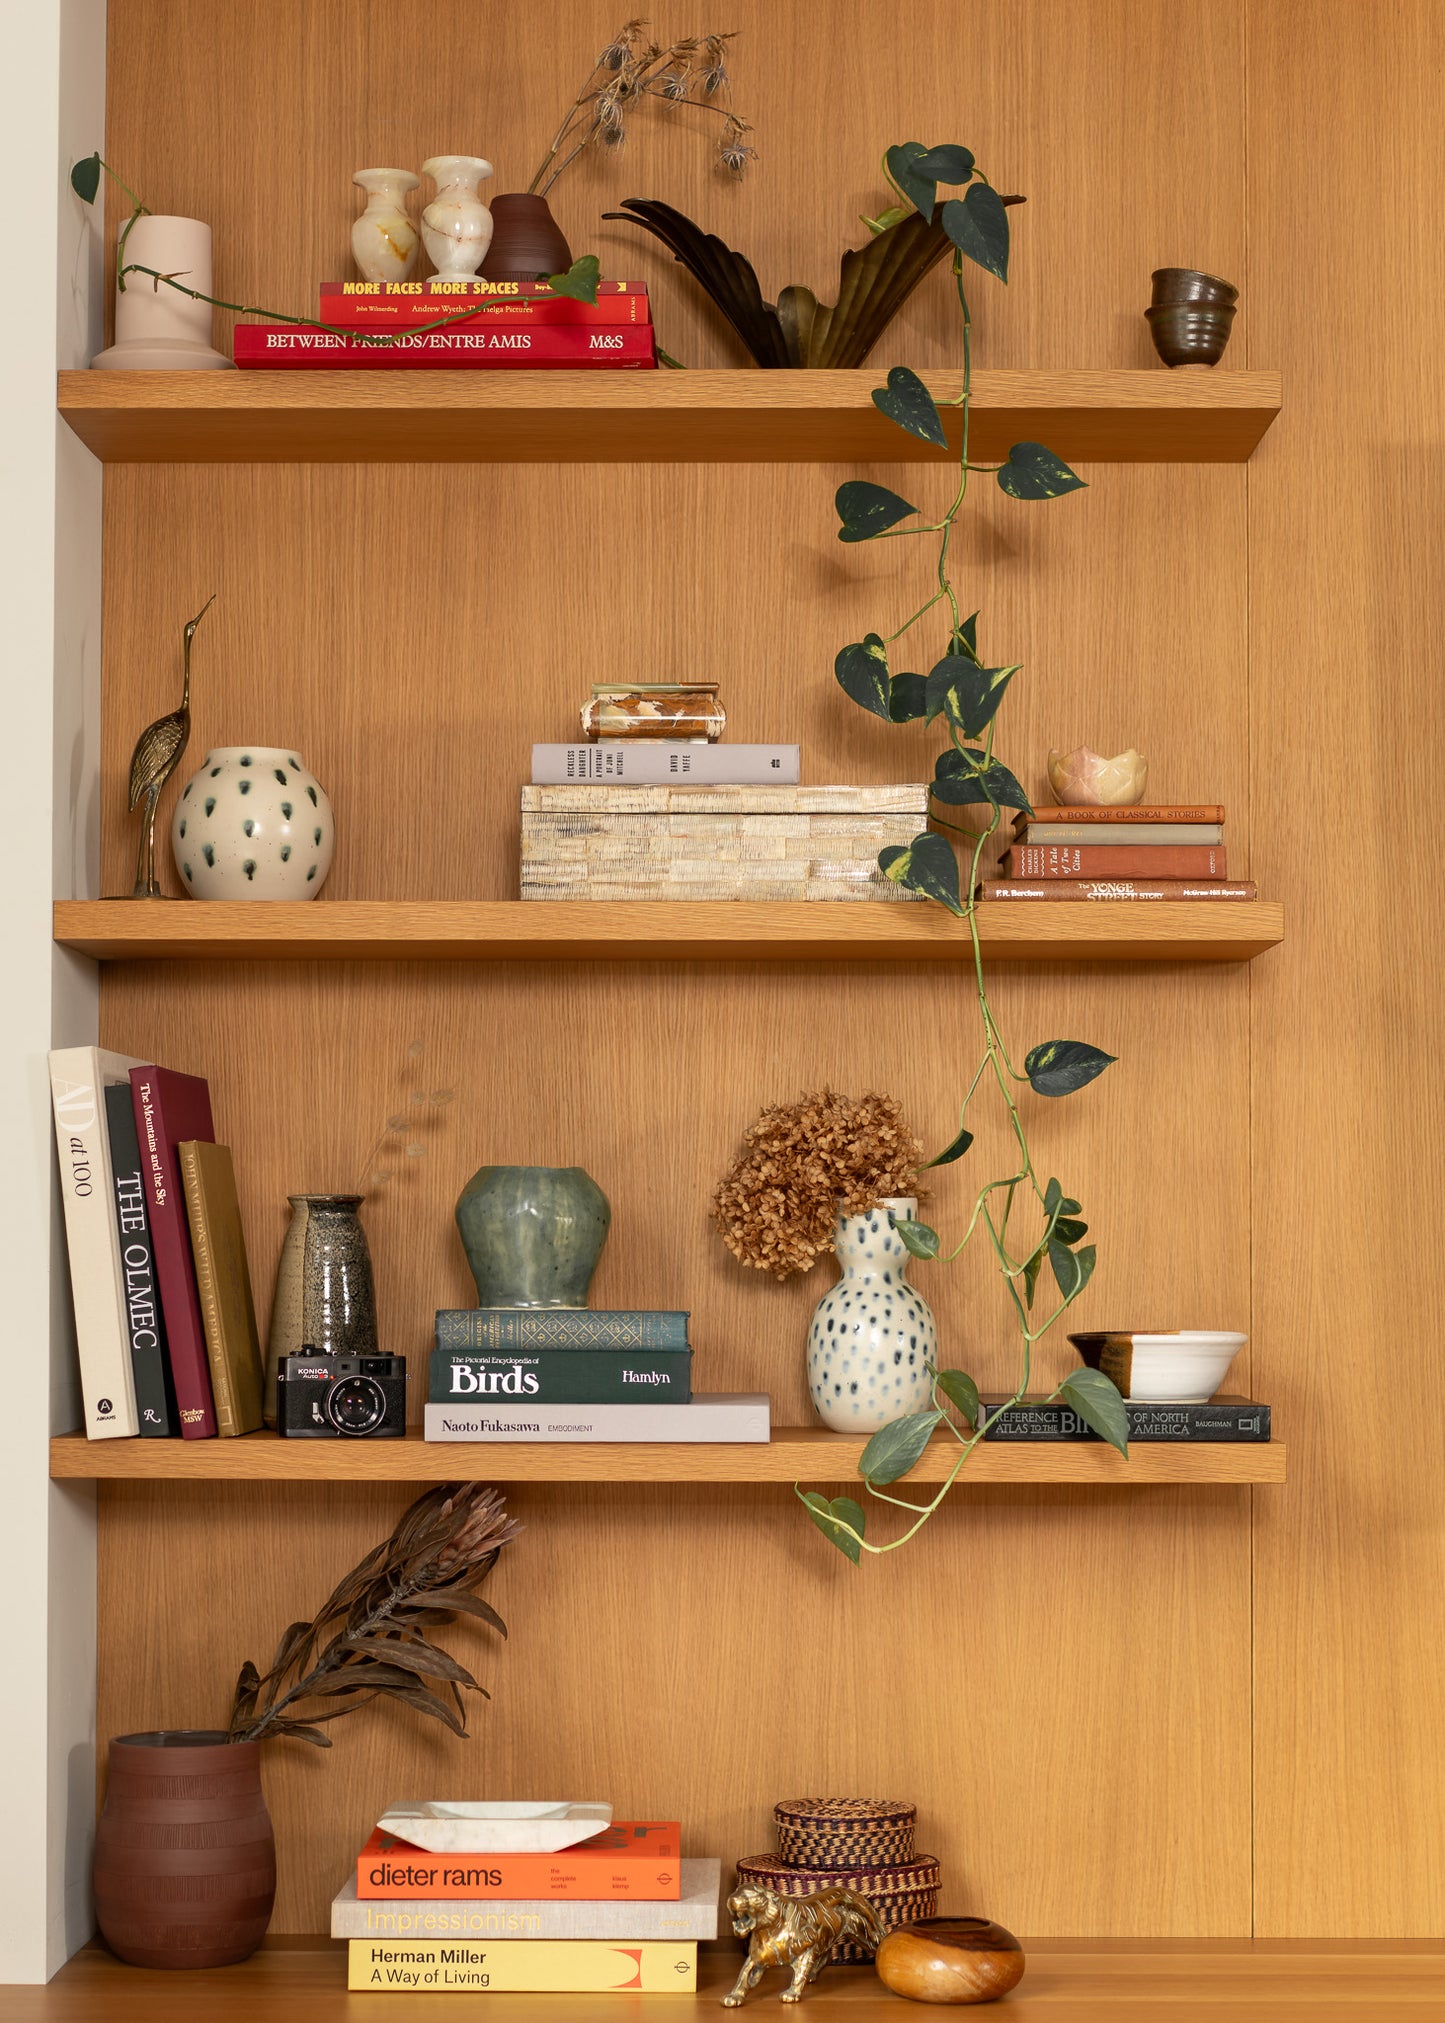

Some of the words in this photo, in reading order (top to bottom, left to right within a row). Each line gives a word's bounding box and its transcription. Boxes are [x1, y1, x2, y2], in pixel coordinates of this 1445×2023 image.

[343, 282, 380, 295] MORE
[386, 282, 423, 295] FACES
[430, 282, 467, 295] MORE
[473, 282, 519, 295] SPACES
[412, 305, 439, 313] Andrew
[441, 305, 466, 314] Wyeth:
[506, 305, 533, 313] Pictures
[266, 334, 347, 349] BETWEEN
[488, 334, 532, 349] AMIS
[589, 335, 624, 349] M&S
[567, 750, 575, 777] RECKLESS
[670, 755, 678, 772] DAVID
[682, 755, 691, 772] YAFFE
[1056, 812, 1063, 820] A
[1067, 811, 1095, 820] BOOK
[1099, 811, 1112, 819] OF
[1116, 810, 1163, 819] CLASSICAL
[1167, 810, 1206, 819] STORIES
[1050, 847, 1058, 864] Tale
[1072, 849, 1080, 871] Cities
[1050, 866, 1058, 875] A
[1062, 864, 1071, 874] of
[1010, 889, 1044, 897] Berchem
[1091, 882, 1135, 893] YONGE
[1086, 892, 1137, 902] STREET
[1138, 892, 1164, 900] STORY
[140, 1082, 151, 1103] The
[53, 1075, 96, 1132] AD
[143, 1104, 158, 1152] Mountains
[70, 1137, 87, 1155] at
[151, 1153, 162, 1171] and
[73, 1160, 93, 1197] 100
[153, 1171, 163, 1188] the
[184, 1154, 198, 1189] JOHN
[117, 1171, 146, 1234] THE
[155, 1188, 166, 1206] Sky
[124, 1244, 158, 1349] OLMEC
[491, 1356, 532, 1365] Encyclopedia
[449, 1364, 540, 1395] Birds
[622, 1370, 671, 1386] Hamlyn
[96, 1414, 116, 1422] ABRAMS
[183, 1414, 203, 1424] MSW
[441, 1419, 478, 1432] Naoto
[480, 1419, 540, 1432] Fukasawa
[995, 1412, 1058, 1423] REFERENCE
[1133, 1412, 1148, 1422] OF
[1151, 1412, 1189, 1423] NORTH
[1195, 1420, 1232, 1428] BAUGHMAN
[995, 1423, 1028, 1434] ATLAS
[1030, 1424, 1041, 1432] TO
[1041, 1424, 1058, 1432] THE
[1134, 1424, 1190, 1435] AMERICA
[369, 1863, 438, 1886] dieter
[443, 1869, 503, 1886] rams
[367, 1908, 541, 1934] Impressionism
[371, 1949, 435, 1963] Herman
[440, 1950, 487, 1964] Miller
[371, 1969, 382, 1983] A
[386, 1969, 421, 1986] Way
[424, 1969, 440, 1983] of
[444, 1970, 491, 1987] Living
